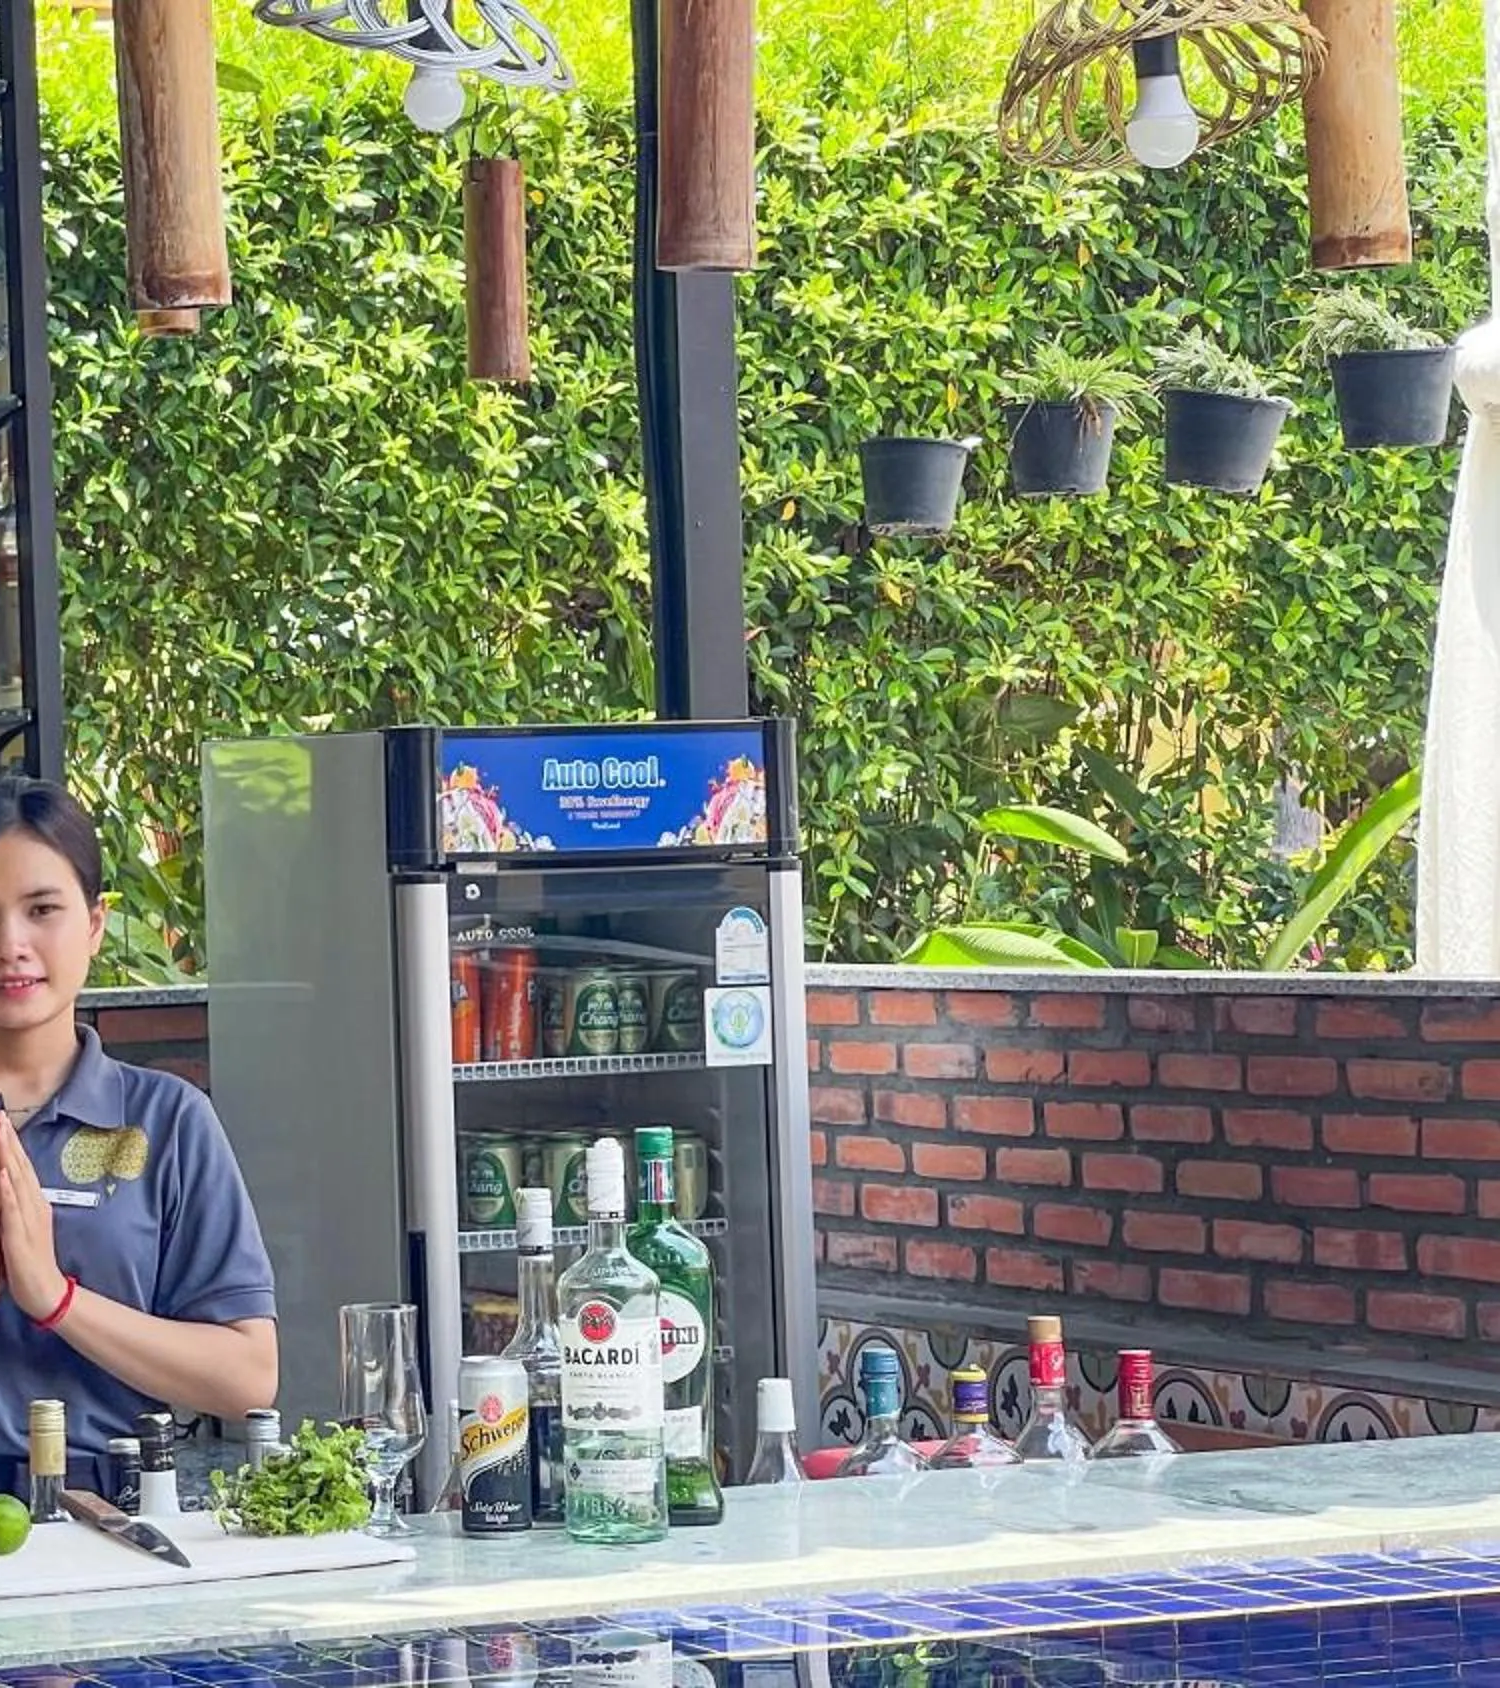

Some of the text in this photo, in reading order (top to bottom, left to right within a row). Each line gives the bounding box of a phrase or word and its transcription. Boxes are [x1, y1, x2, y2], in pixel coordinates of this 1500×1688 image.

[542, 758, 600, 790] Auto
[457, 926, 536, 942] AUTO COOL
[660, 1326, 699, 1345] TINI
